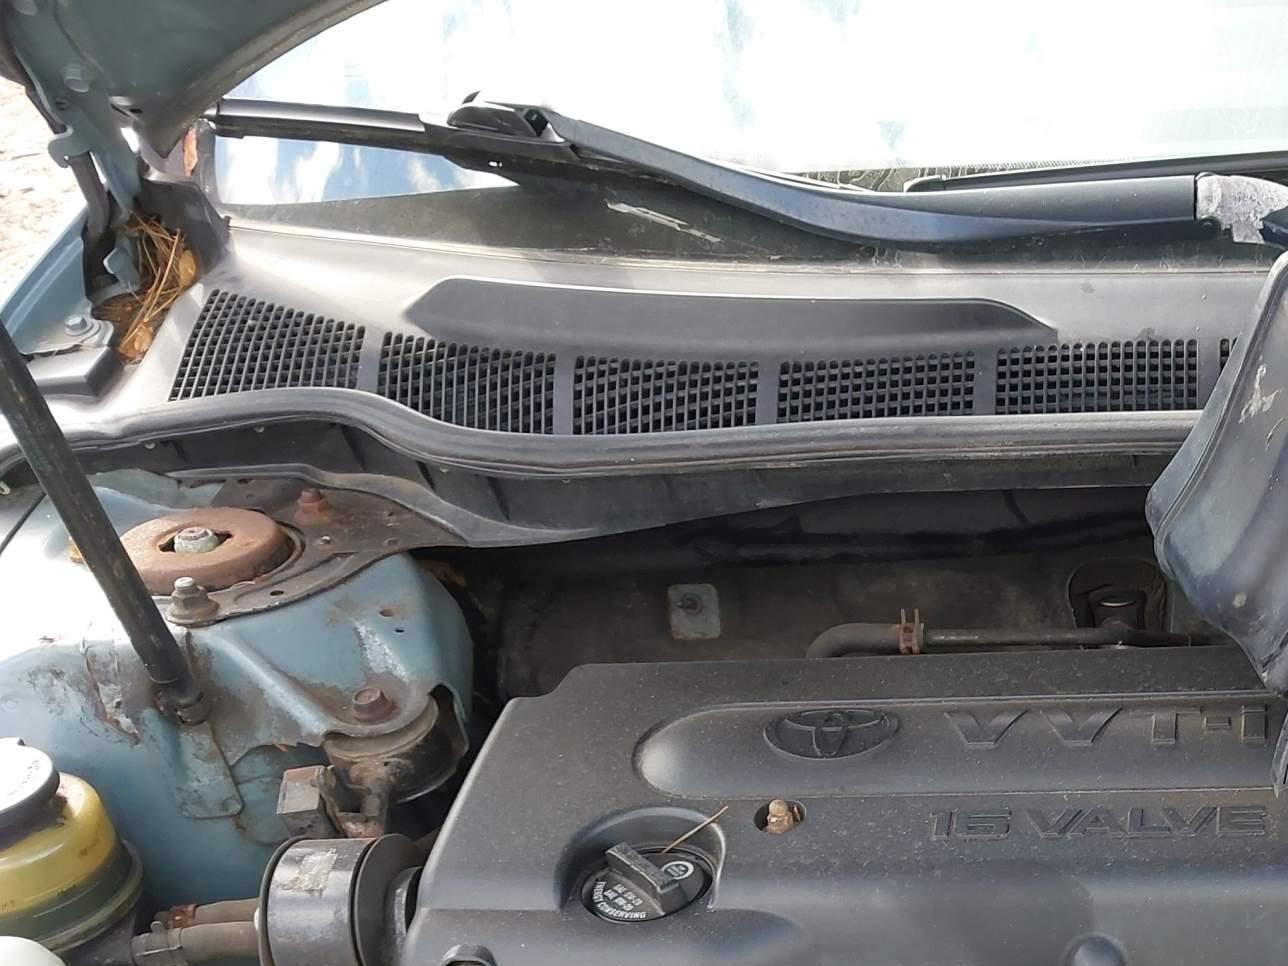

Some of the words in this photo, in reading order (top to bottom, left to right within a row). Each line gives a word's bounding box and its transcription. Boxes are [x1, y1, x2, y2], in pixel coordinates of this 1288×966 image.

[929, 805, 1013, 841] 16
[1024, 804, 1267, 841] VALVE
[596, 902, 647, 919] CONSERVING
